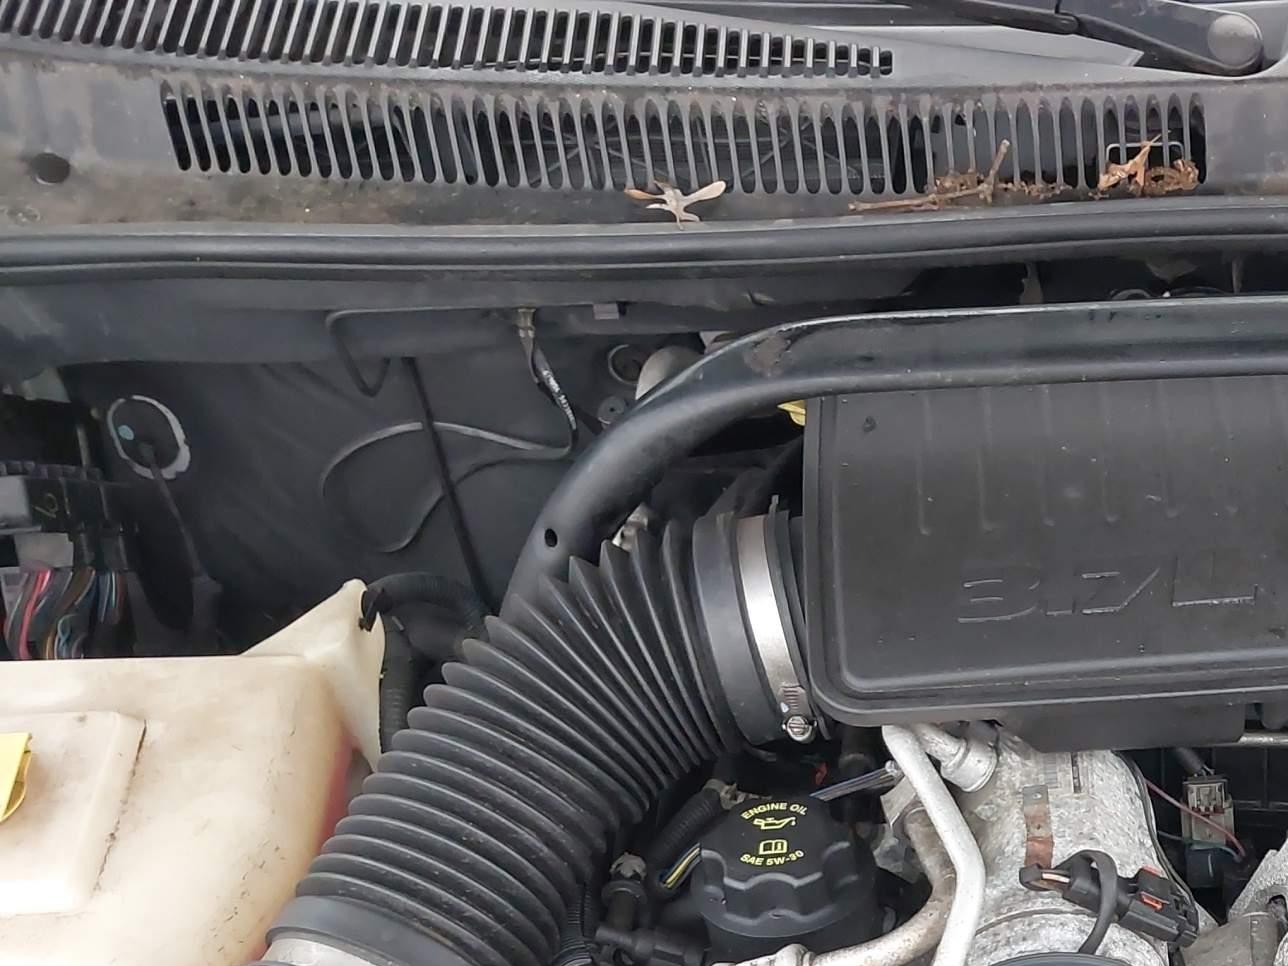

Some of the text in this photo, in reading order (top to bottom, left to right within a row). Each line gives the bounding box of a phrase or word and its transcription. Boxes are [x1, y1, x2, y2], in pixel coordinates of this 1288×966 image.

[958, 553, 1257, 623] 3.7L
[740, 802, 808, 820] ENGINE OIL
[740, 849, 805, 866] SAE 5W-30
